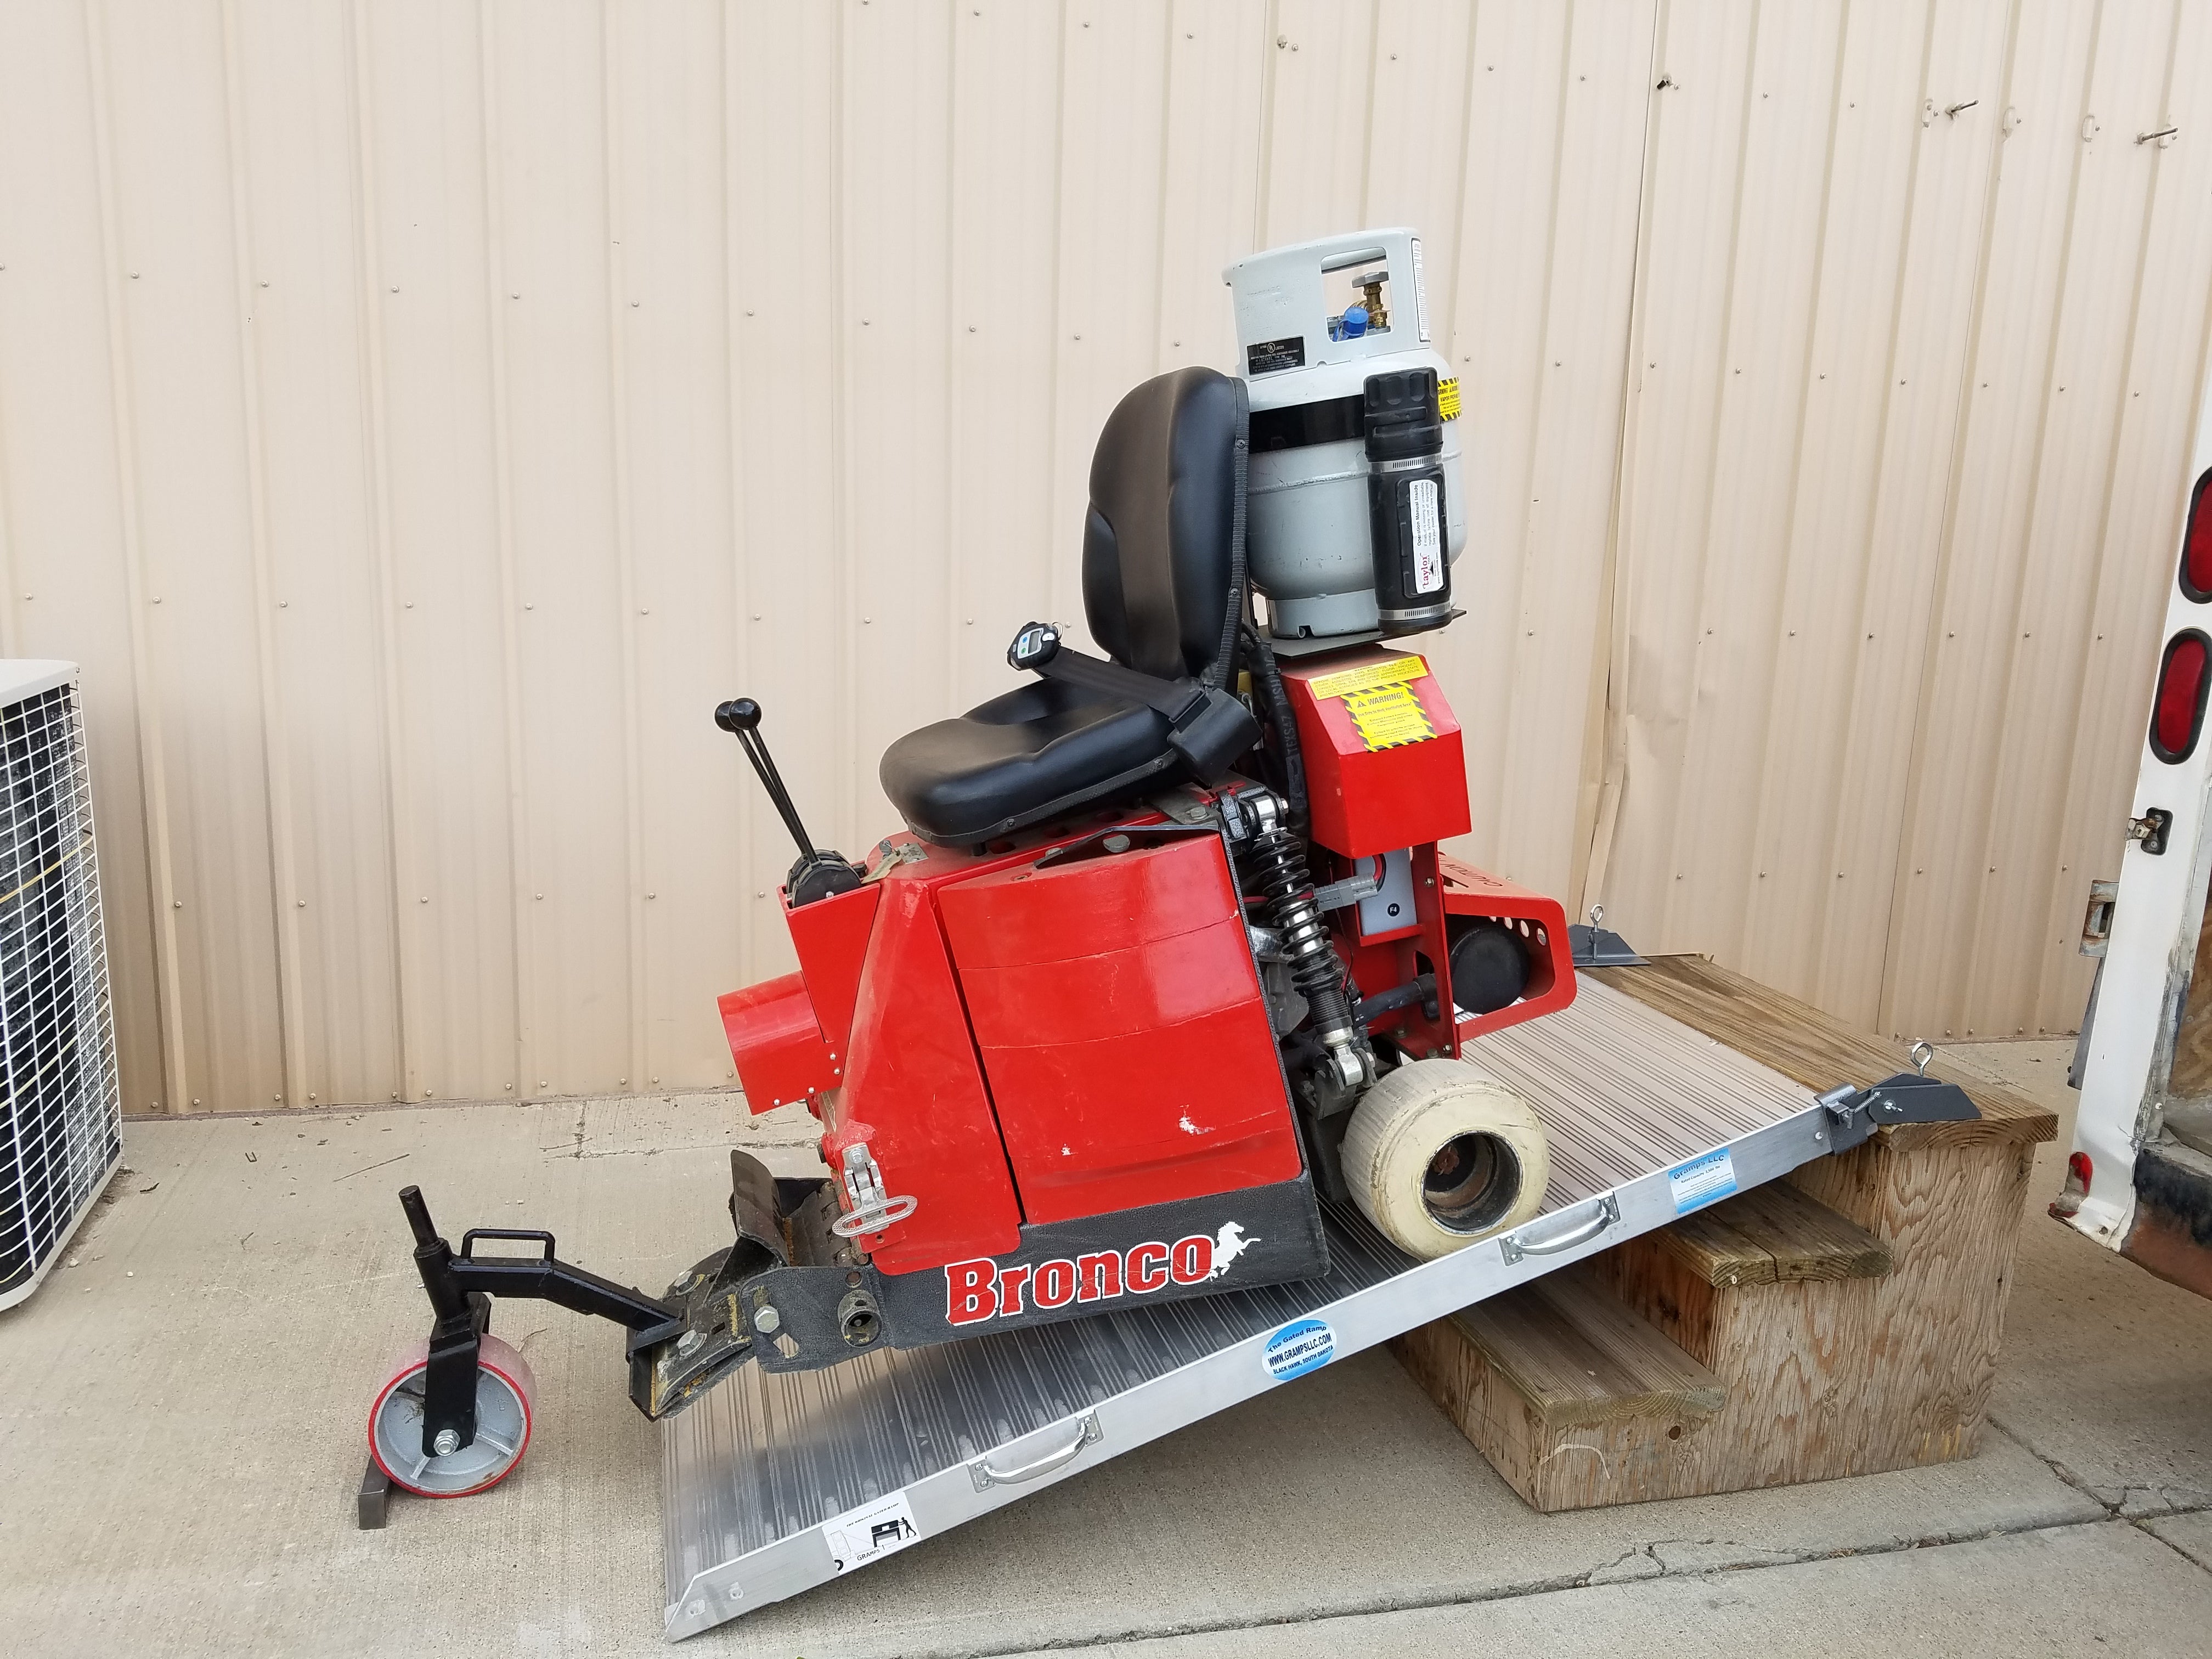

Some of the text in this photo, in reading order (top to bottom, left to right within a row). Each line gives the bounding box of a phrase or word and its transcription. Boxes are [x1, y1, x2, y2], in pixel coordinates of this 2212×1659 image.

[1420, 553, 1429, 589] taylor
[1368, 692, 1403, 705] WARNING!
[1674, 1155, 1724, 1179] Gramps LLC
[944, 1234, 1216, 1327] Bronco
[1268, 1342, 1282, 1353] The
[1283, 1330, 1304, 1343] Gated
[1268, 1333, 1332, 1368] WWW.GRAMPSLLC.COM
[1273, 1345, 1334, 1374] BLACK HAWK, SOUTH DAKOTA
[855, 1514, 872, 1523] ORIGINAL
[857, 1549, 879, 1560] GRAMPS
